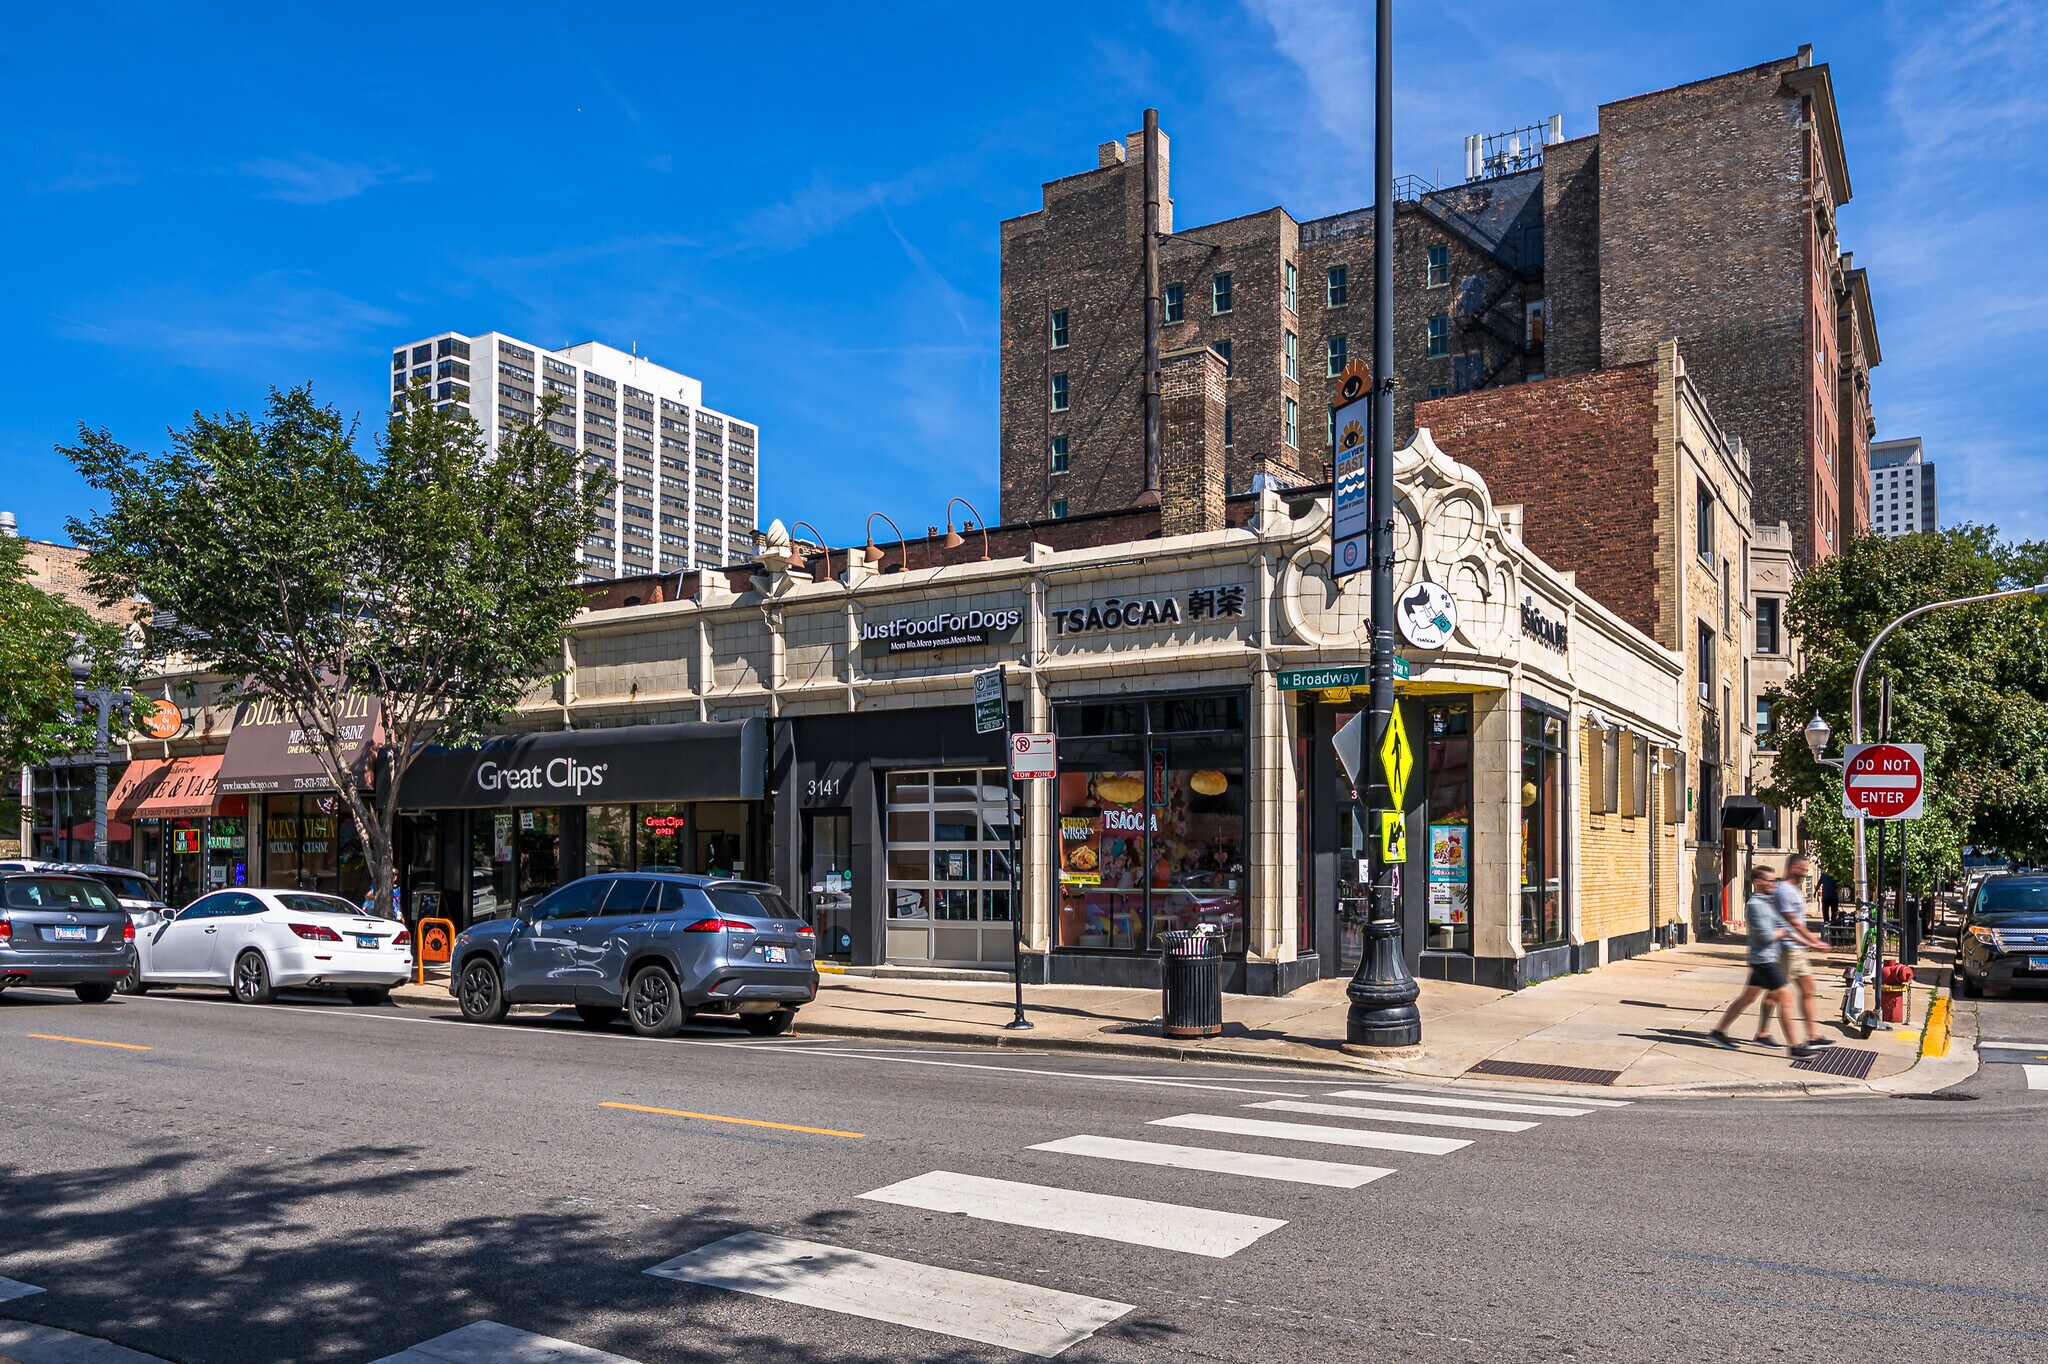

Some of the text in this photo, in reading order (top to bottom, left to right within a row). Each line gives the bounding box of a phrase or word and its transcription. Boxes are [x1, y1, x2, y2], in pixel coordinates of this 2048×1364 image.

[1338, 445, 1365, 462] LAKE VIEW
[1338, 453, 1365, 477] EAST
[858, 610, 1019, 641] JustFoodForDogs
[890, 642, 905, 650] More
[1282, 672, 1359, 686] N Broadway
[162, 715, 170, 724] &
[1856, 759, 1911, 771] DO NOT
[477, 761, 542, 790] Great
[1153, 752, 1164, 803] OPEN
[116, 779, 171, 801] SMOKE
[168, 776, 185, 798] &
[808, 779, 840, 795] 3141
[1861, 791, 1904, 803] ENTER
[267, 818, 335, 839] BUENA VISTA
[646, 816, 684, 829] Great Clips
[655, 828, 674, 836] OPEN
[269, 841, 328, 853] MEXICAN CUISINE
